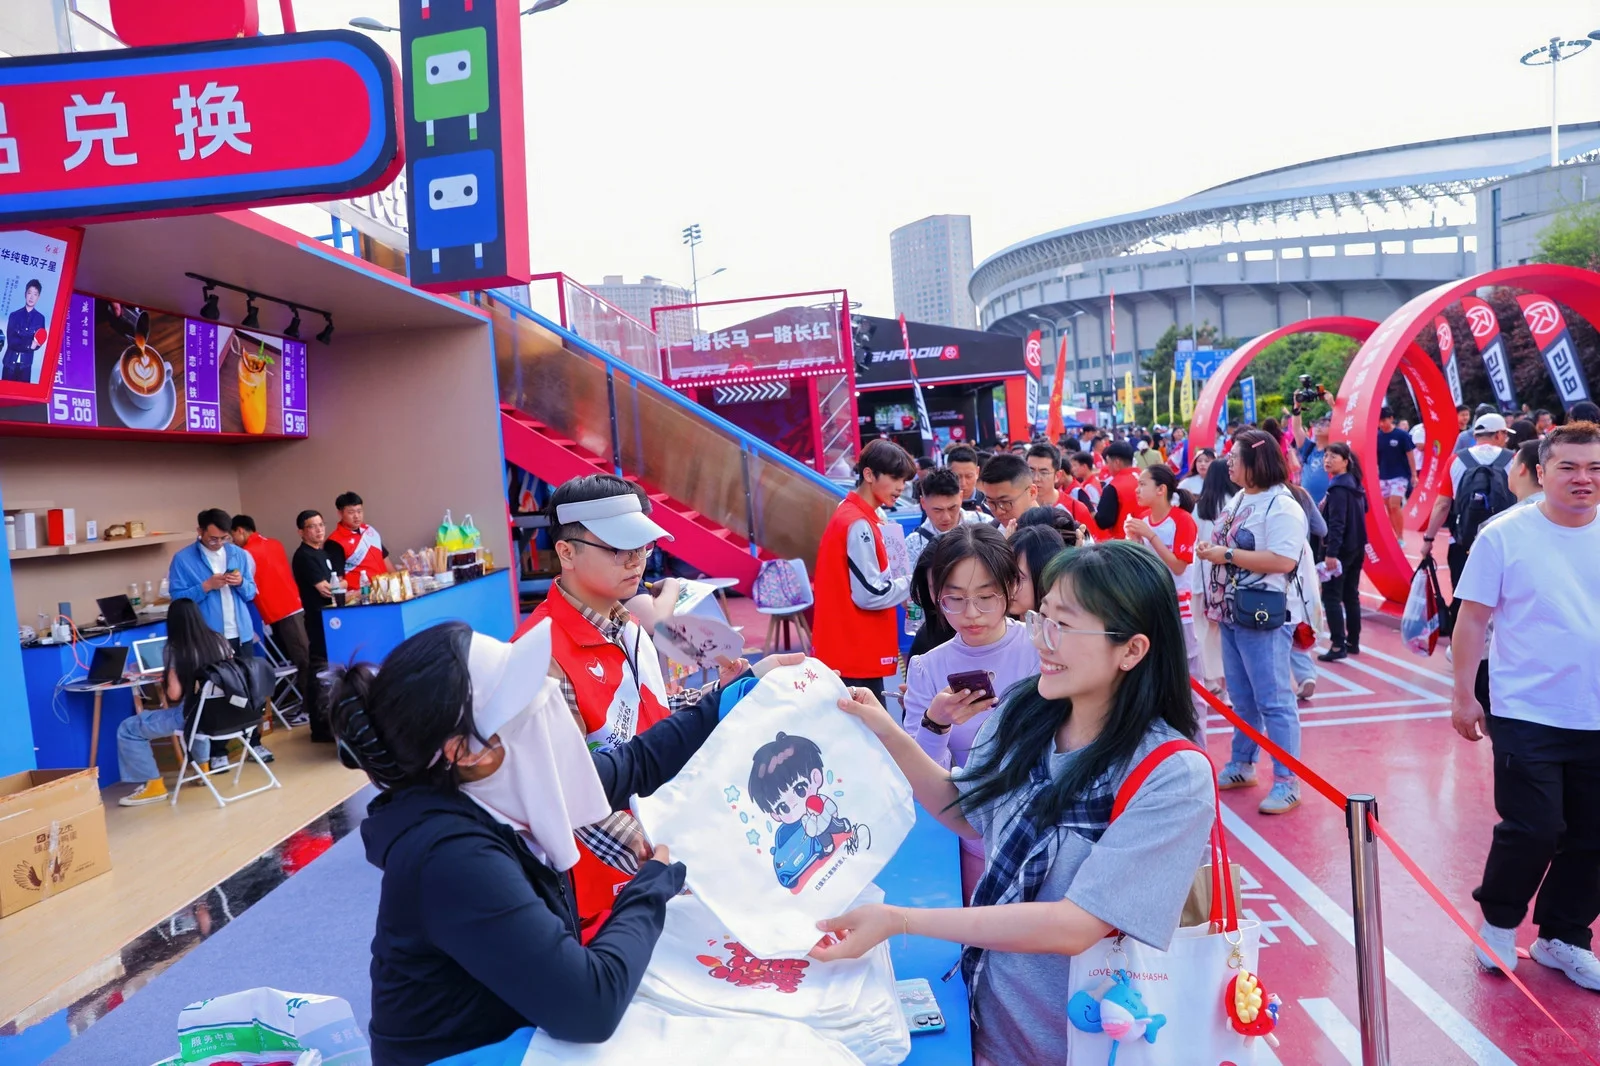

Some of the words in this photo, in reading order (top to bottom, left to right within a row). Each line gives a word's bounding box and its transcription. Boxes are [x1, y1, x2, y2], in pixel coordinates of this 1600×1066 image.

[0, 248, 57, 272] 华纯电双子星
[671, 329, 749, 352] 一路长马
[754, 322, 832, 344] 一路长红
[871, 346, 943, 363] SHADOW
[72, 397, 92, 408] RMB
[202, 408, 216, 417] RMB
[1088, 968, 1111, 977] LOVE
[1142, 972, 1169, 981] SHASHA
[191, 1032, 235, 1048] 服务中国
[191, 1044, 217, 1055] Serving
